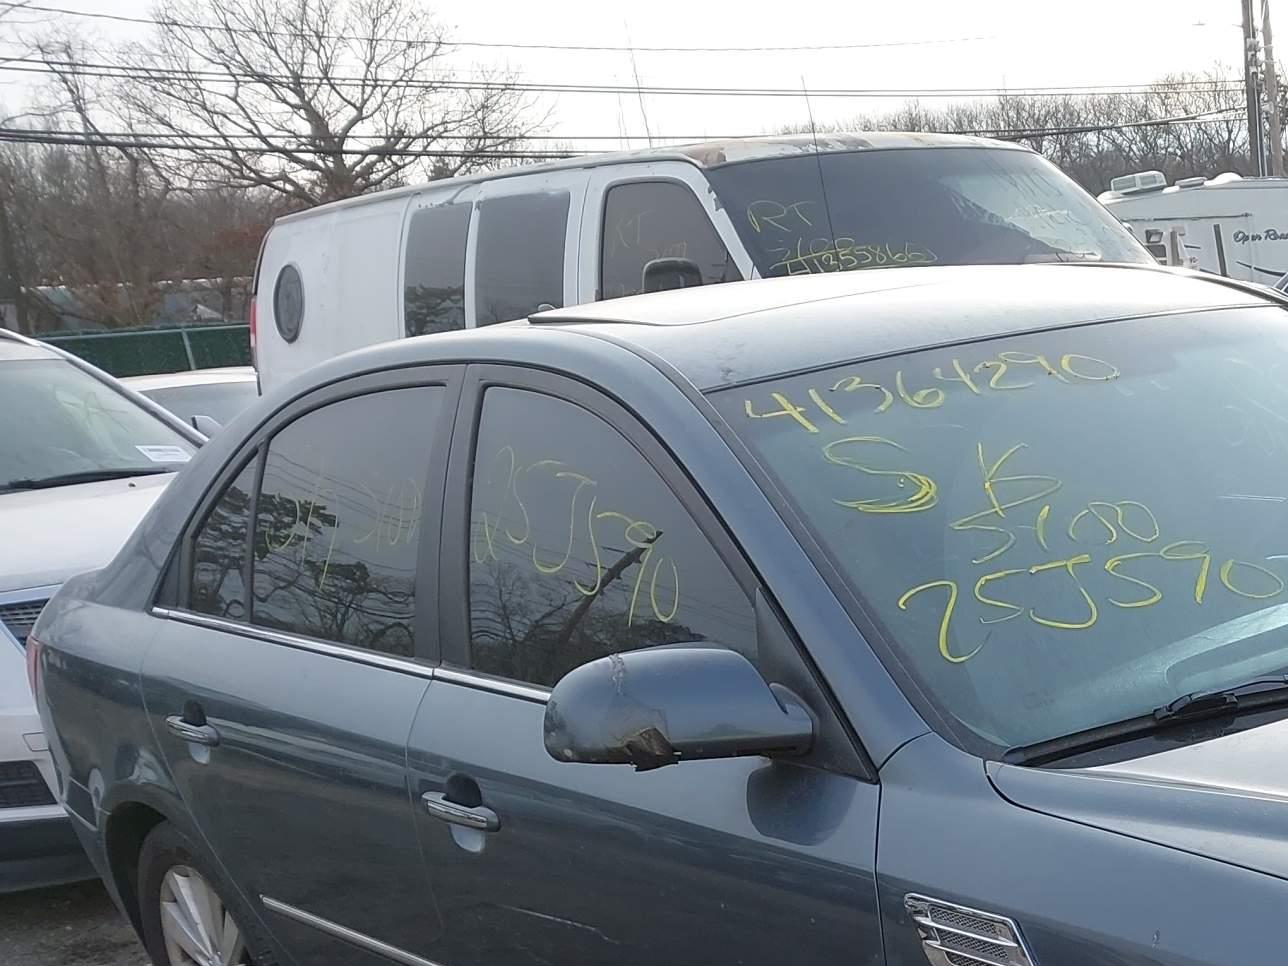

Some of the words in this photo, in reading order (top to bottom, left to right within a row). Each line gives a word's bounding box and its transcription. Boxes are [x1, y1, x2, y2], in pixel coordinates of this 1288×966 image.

[747, 200, 815, 233] RT
[1233, 230, 1263, 246] Open
[744, 351, 1122, 434] 41364290
